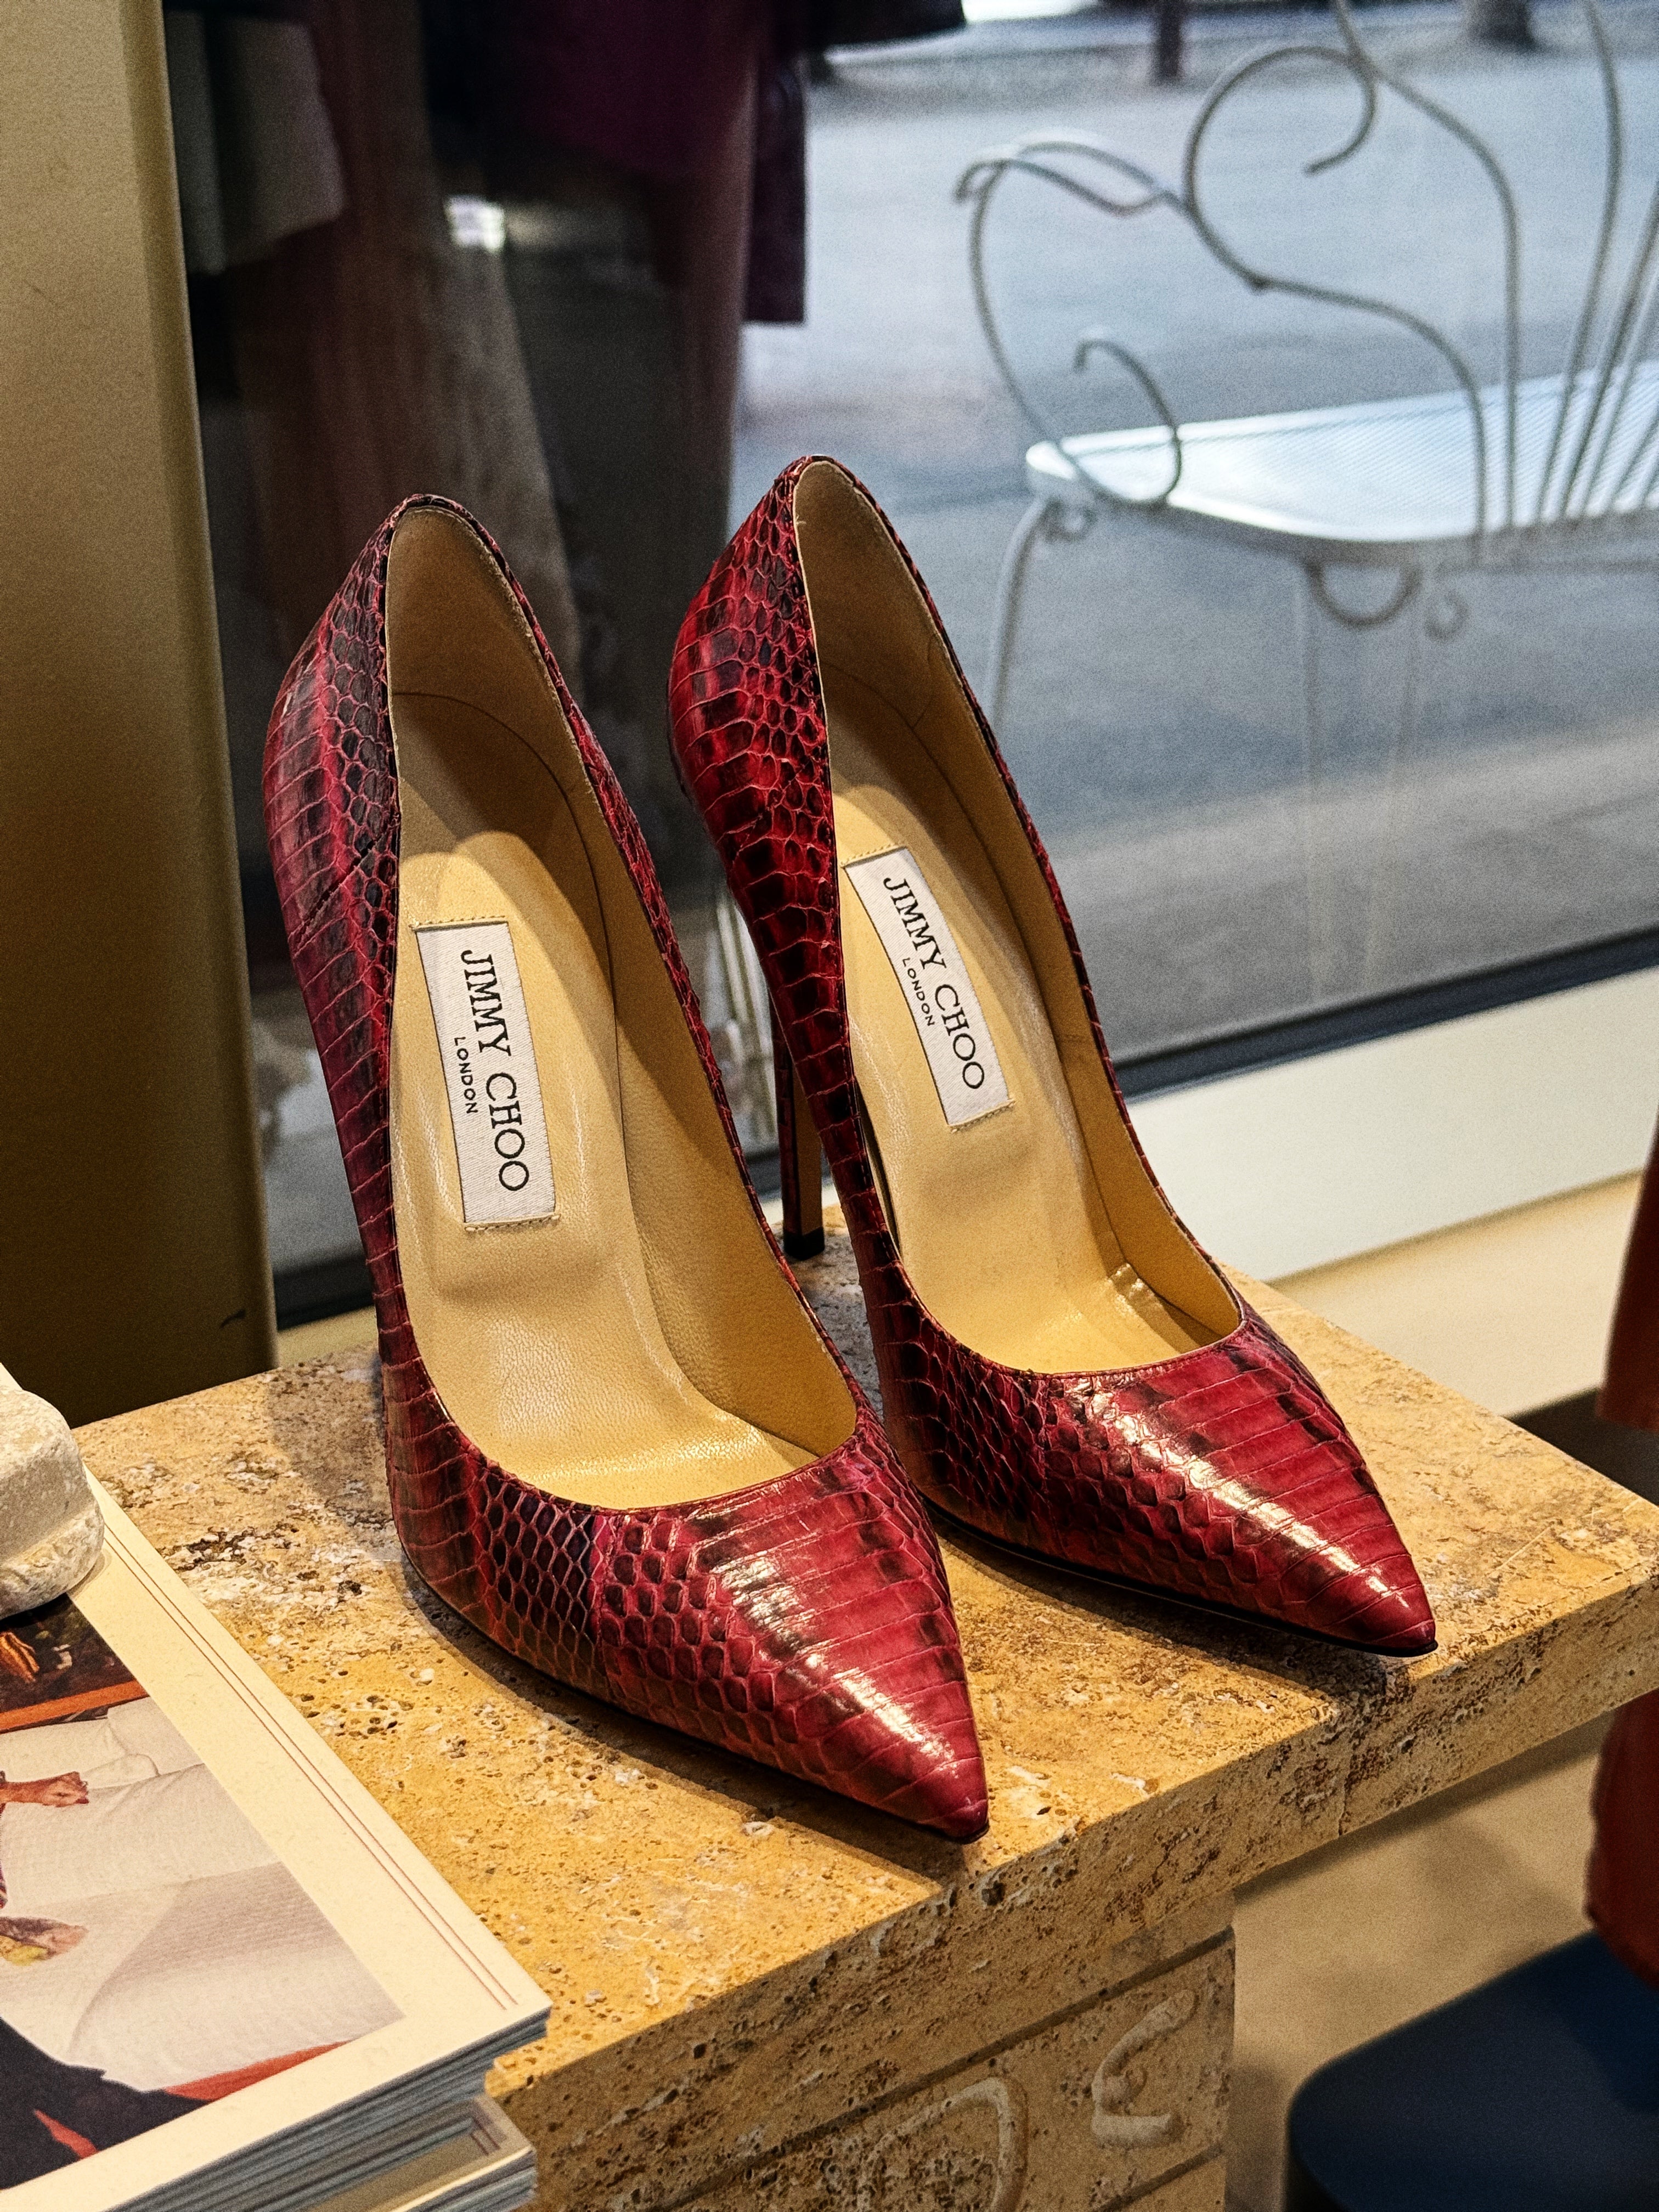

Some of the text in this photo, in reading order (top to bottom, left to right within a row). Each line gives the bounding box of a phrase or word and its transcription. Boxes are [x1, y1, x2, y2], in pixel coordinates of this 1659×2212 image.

[883, 877, 985, 1089] JIMMY CHOO
[902, 957, 935, 1026] LONDON
[454, 1036, 478, 1114] LONDON
[460, 949, 529, 1191] JIMMY CHOO
